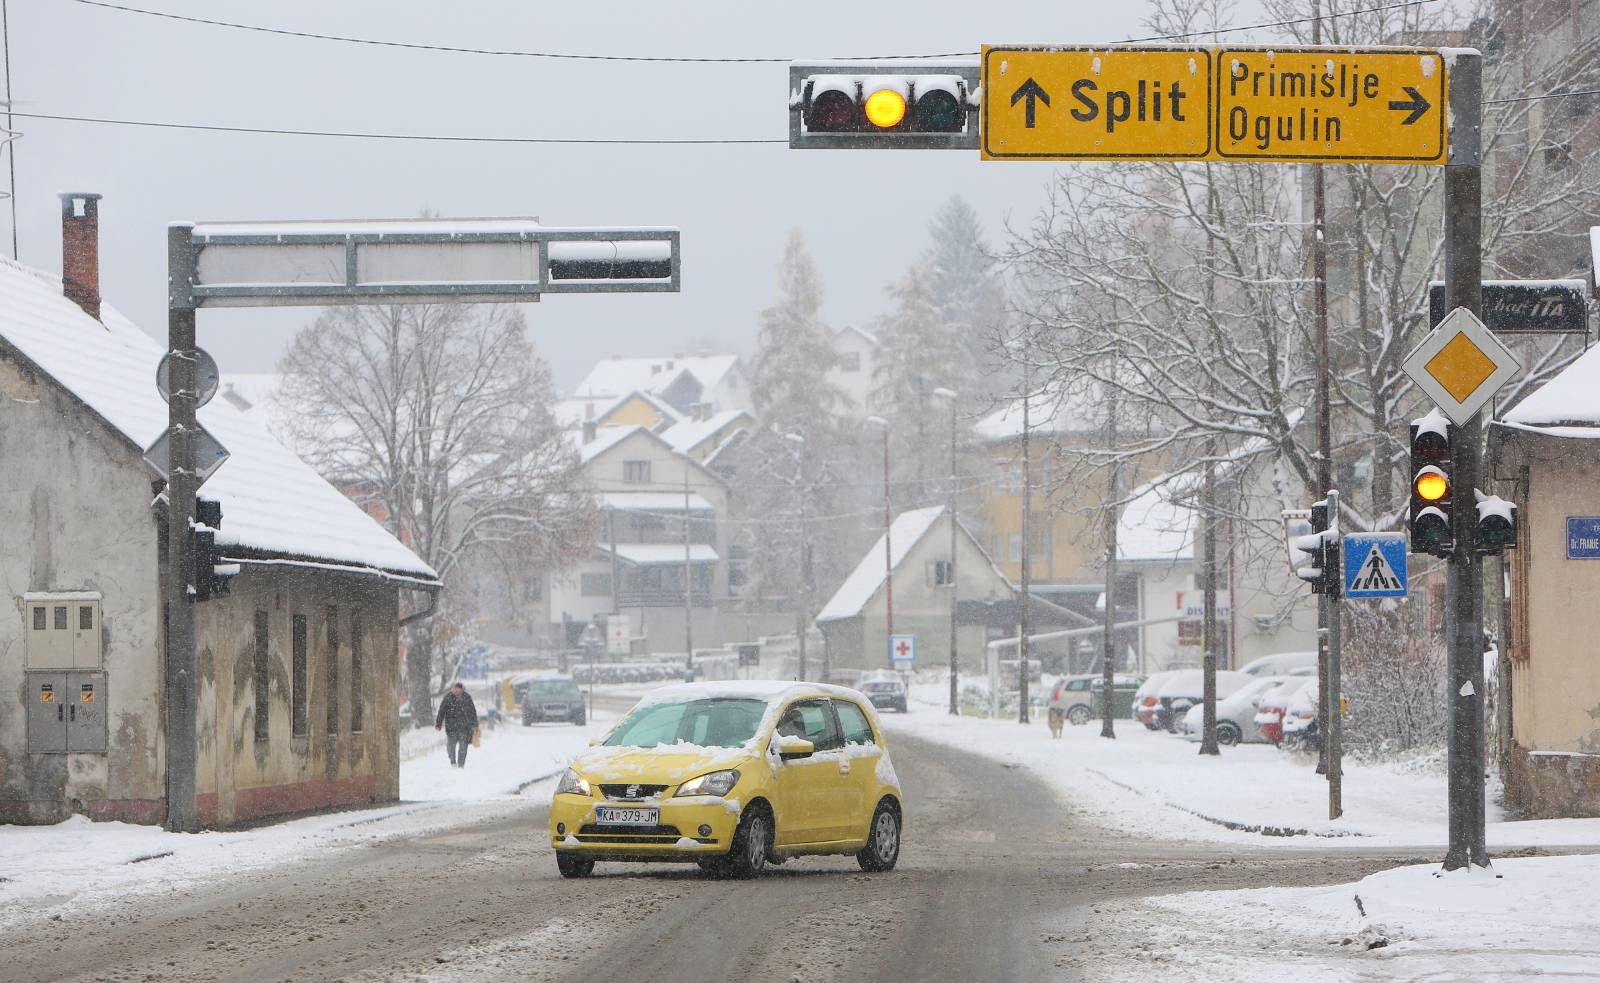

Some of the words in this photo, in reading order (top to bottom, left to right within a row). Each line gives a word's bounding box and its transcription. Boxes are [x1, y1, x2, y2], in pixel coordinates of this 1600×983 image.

[1070, 79, 1186, 133] Split
[1229, 105, 1342, 150] Ogulin
[1579, 539, 1599, 549] FRANJE
[602, 810, 615, 821] KA
[621, 810, 657, 822] 379-JM
